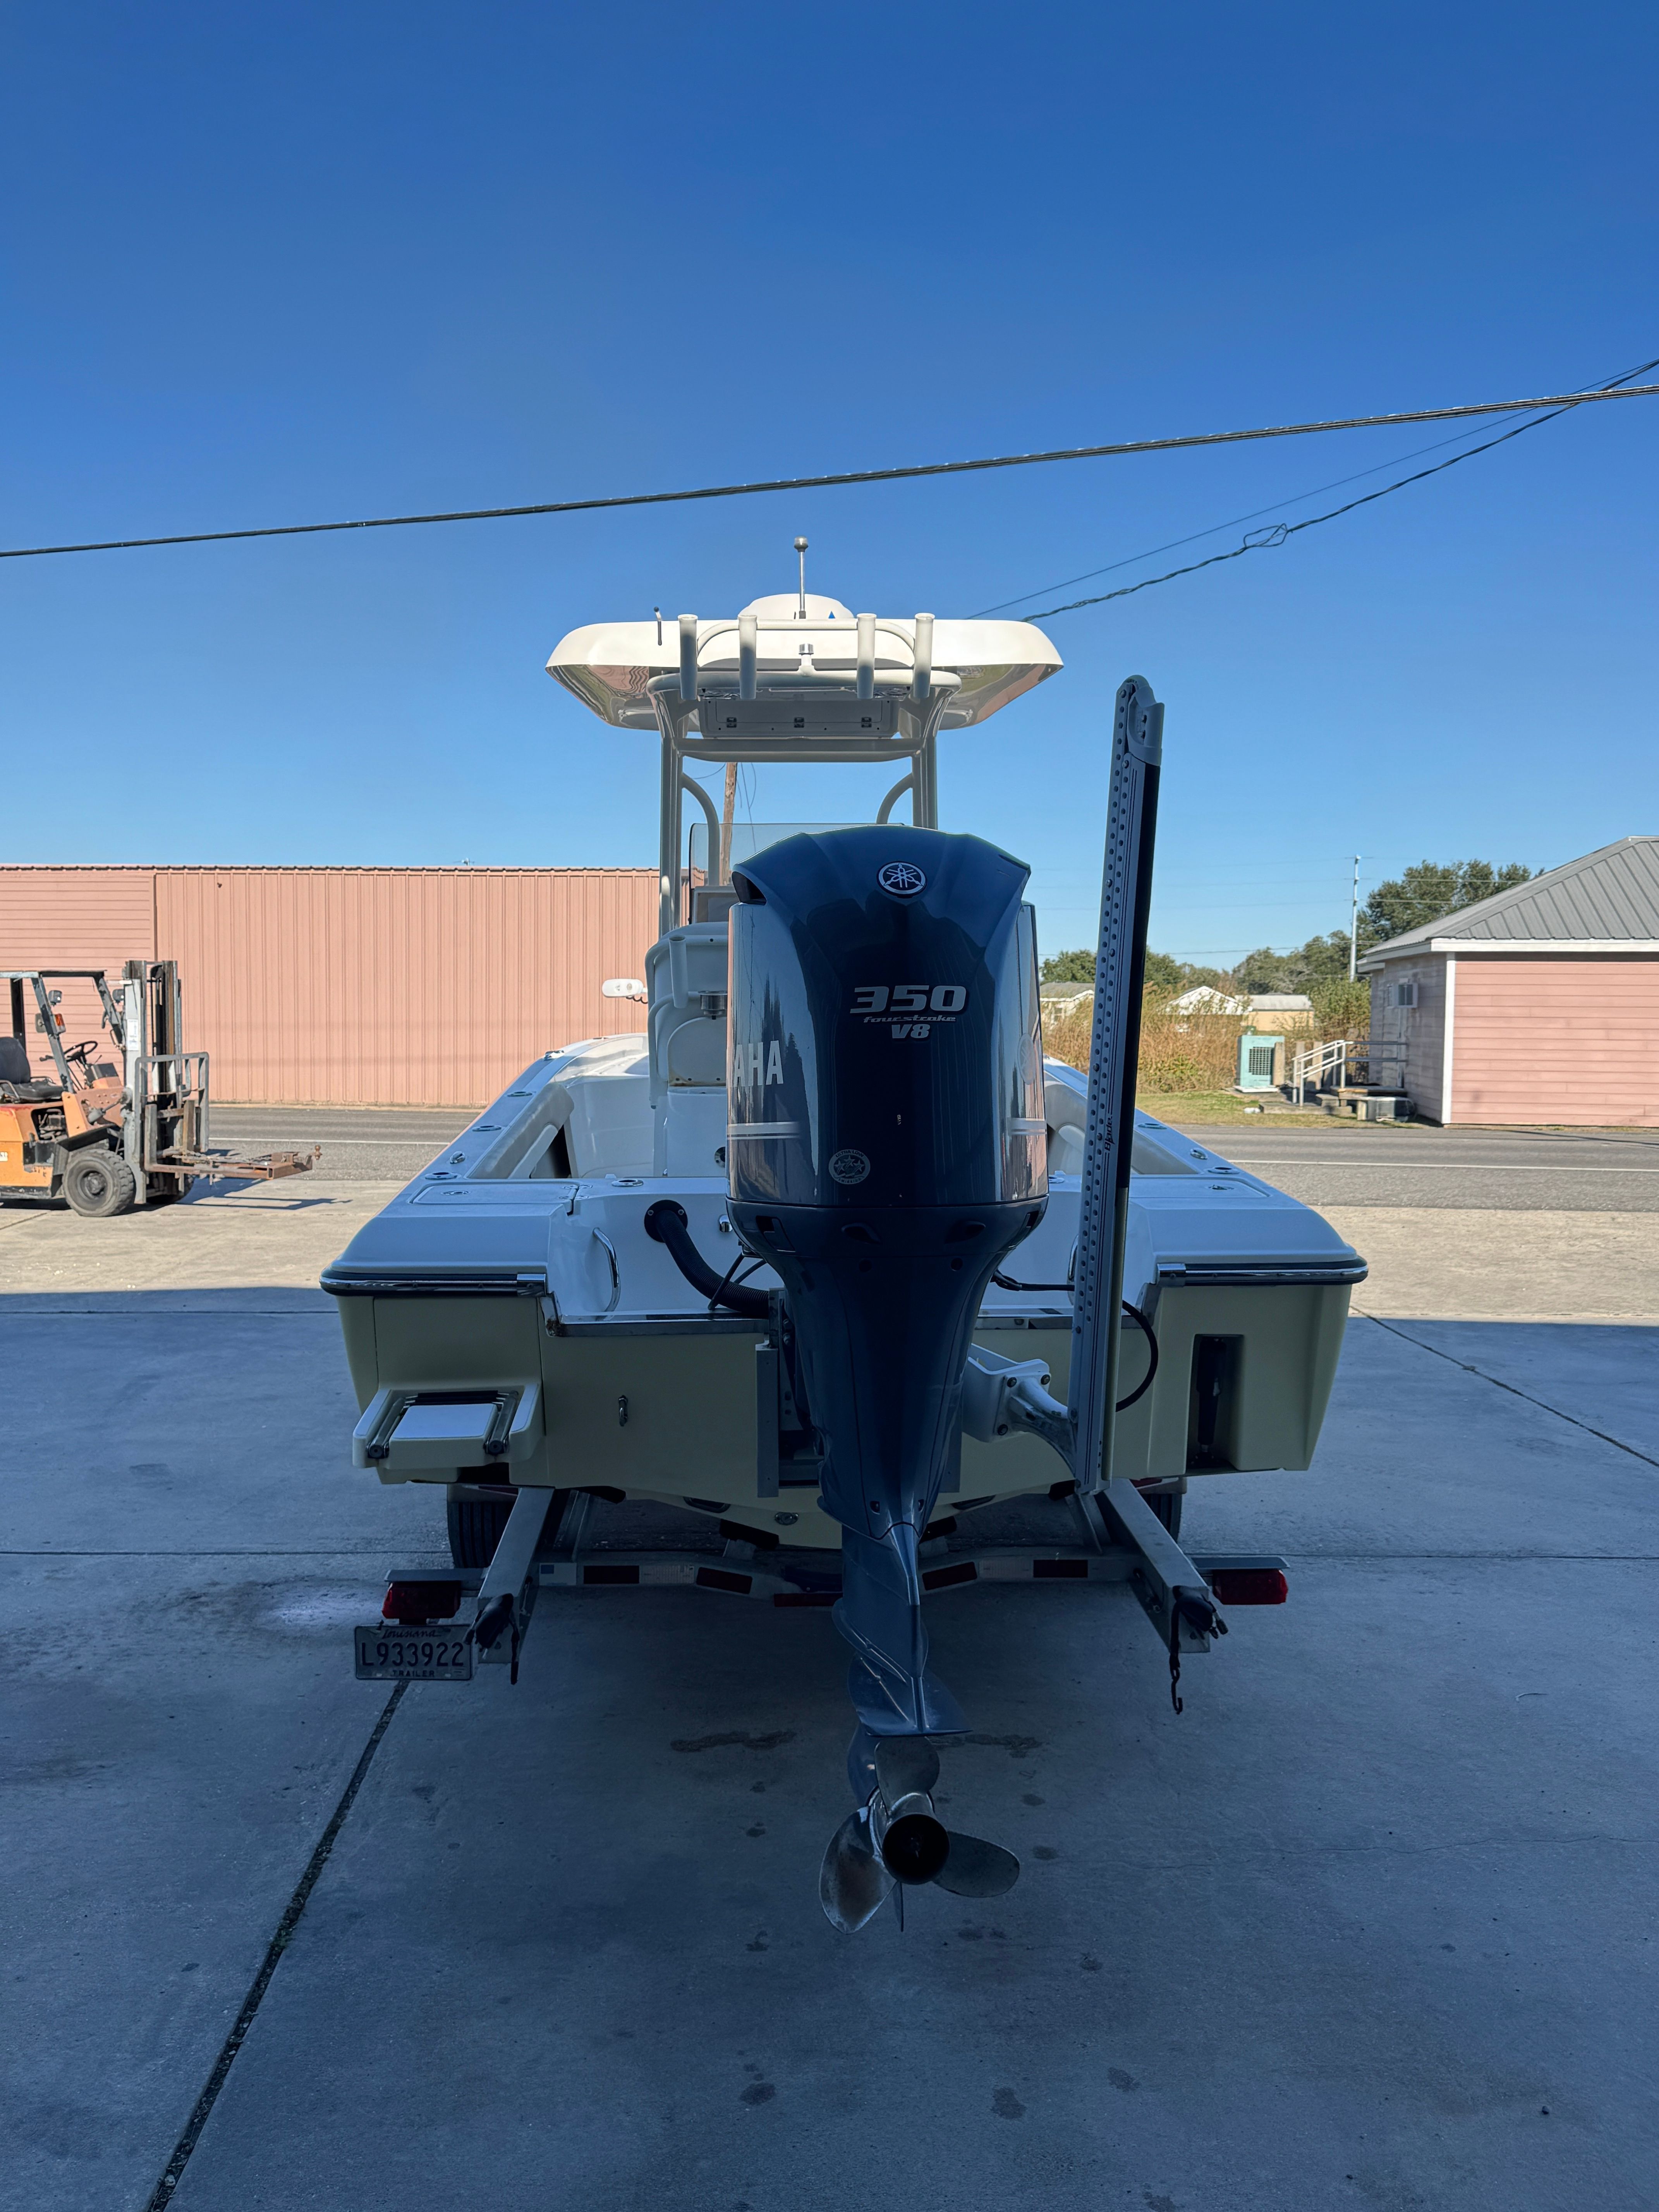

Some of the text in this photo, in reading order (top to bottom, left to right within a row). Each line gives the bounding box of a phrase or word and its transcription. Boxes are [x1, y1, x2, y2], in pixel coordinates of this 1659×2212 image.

[850, 985, 967, 1013] 350
[891, 1024, 930, 1039] V8
[728, 1040, 784, 1087] AHA
[381, 1628, 441, 1639] Louisiana
[362, 1642, 464, 1667] L933922
[391, 1669, 435, 1678] TRAILER
